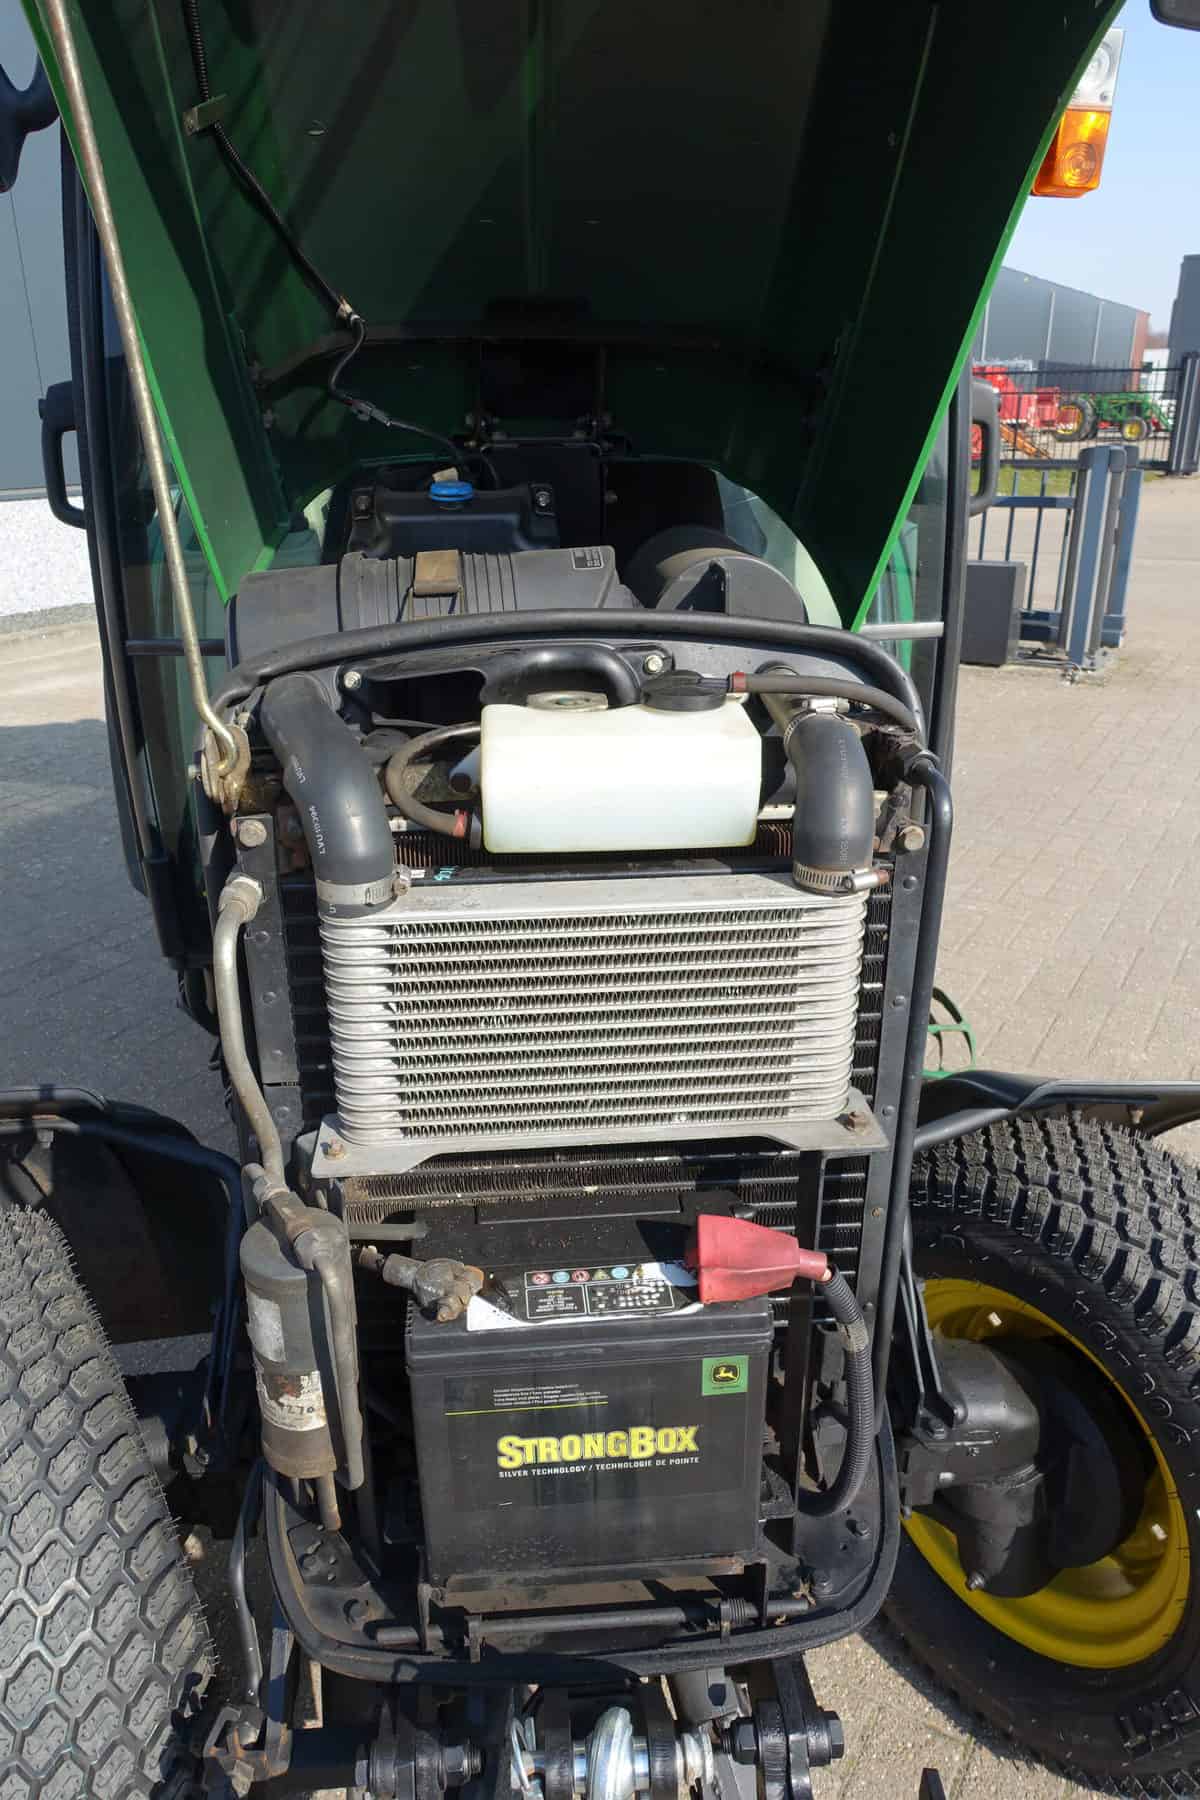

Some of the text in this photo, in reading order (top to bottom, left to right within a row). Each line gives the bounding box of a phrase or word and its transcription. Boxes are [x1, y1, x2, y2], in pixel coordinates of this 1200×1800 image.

[499, 1470, 528, 1478] SILVER
[532, 1464, 586, 1476] TECHNOLOGY
[595, 1459, 652, 1471] TECHNOLOGIE
[669, 1456, 700, 1466] POINTE
